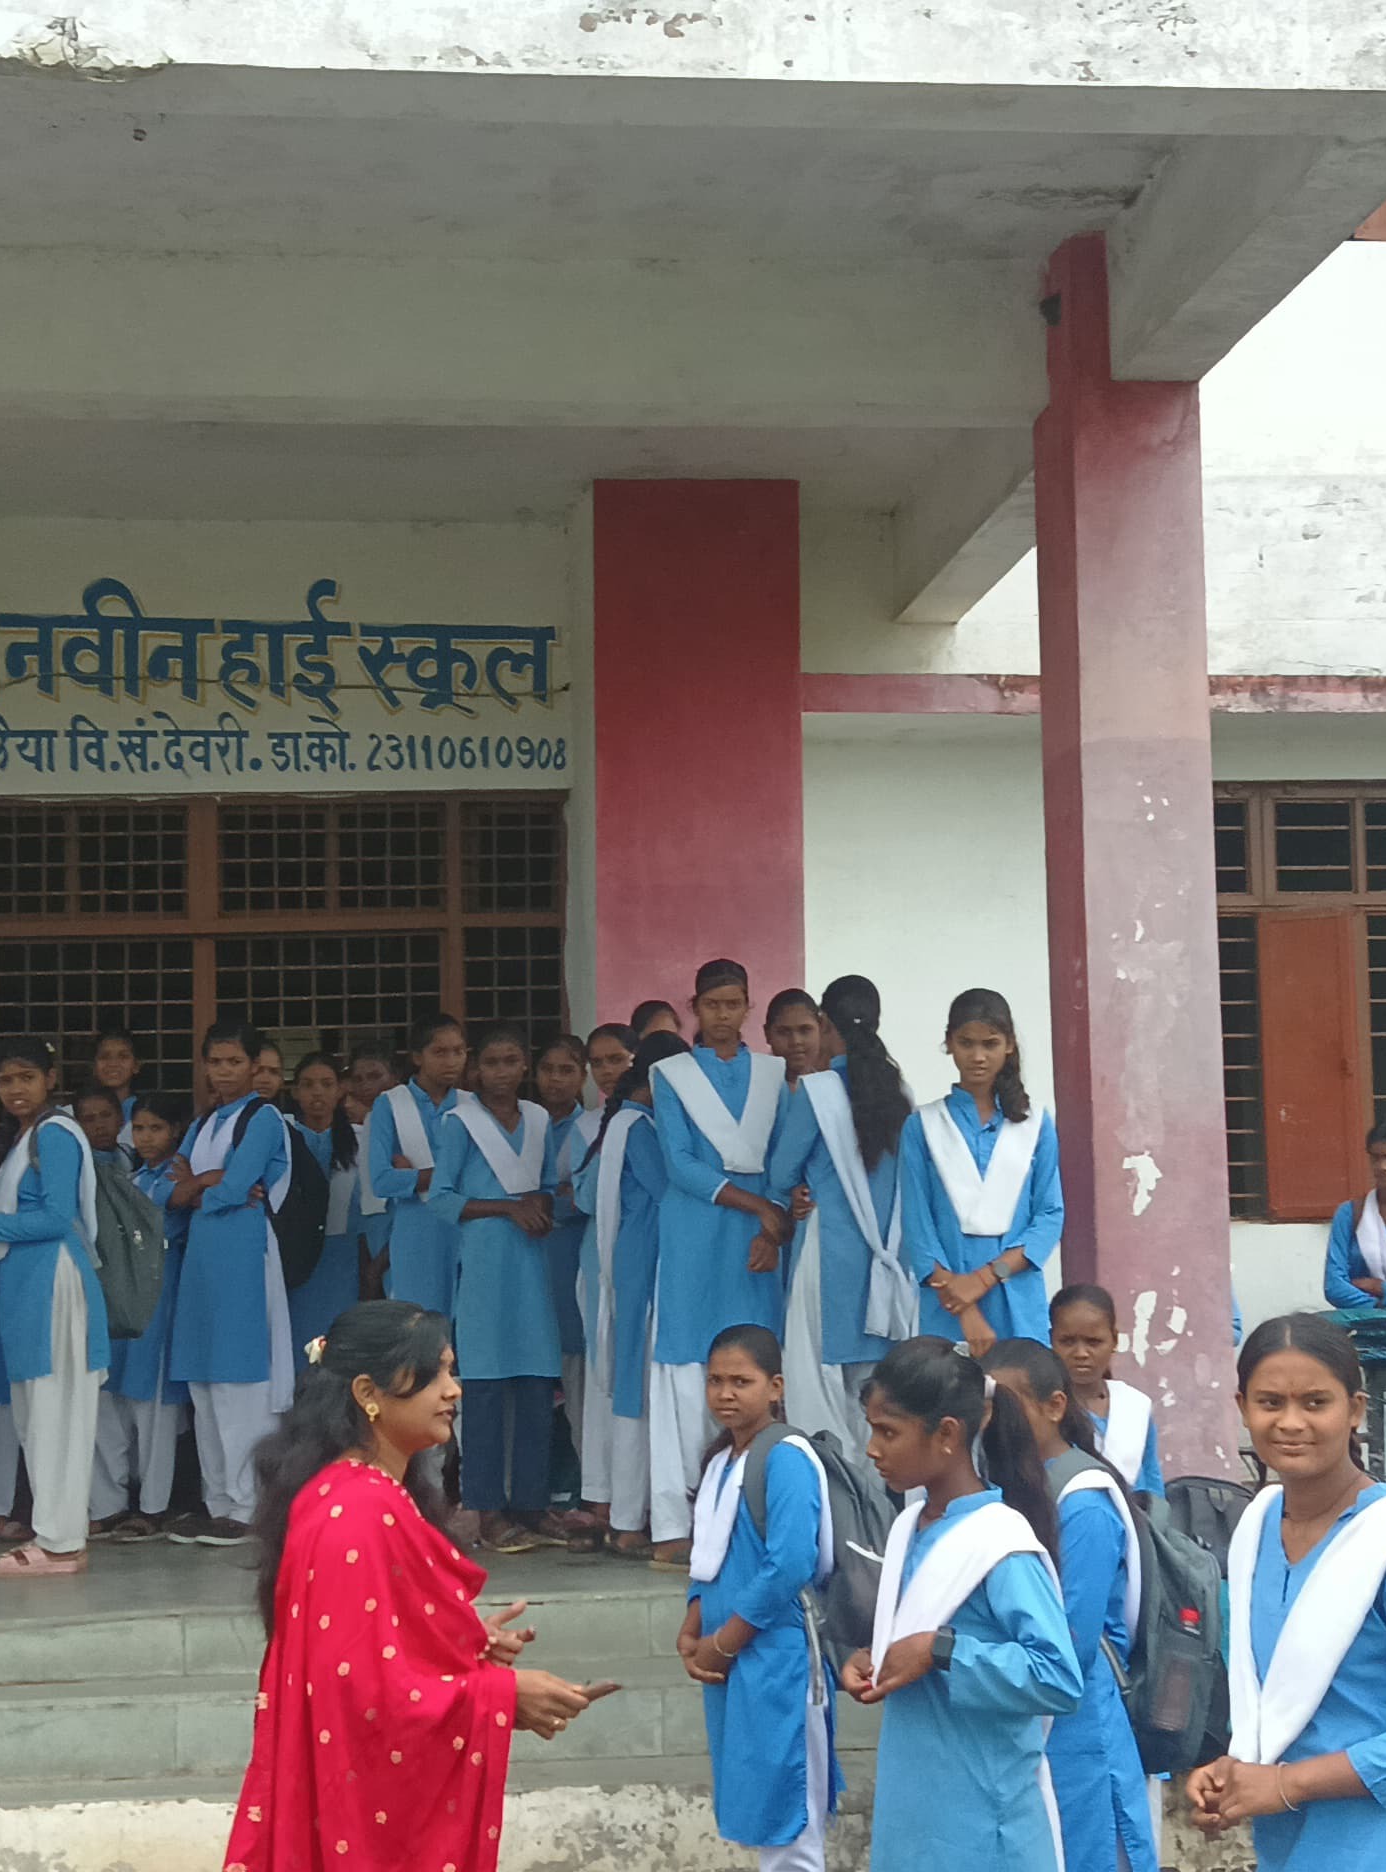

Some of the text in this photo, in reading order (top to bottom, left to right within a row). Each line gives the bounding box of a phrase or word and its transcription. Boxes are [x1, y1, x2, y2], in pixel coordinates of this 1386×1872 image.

[219, 579, 351, 715] हाई
[358, 624, 555, 715] स्कूल
[367, 733, 566, 771] 23110610908
